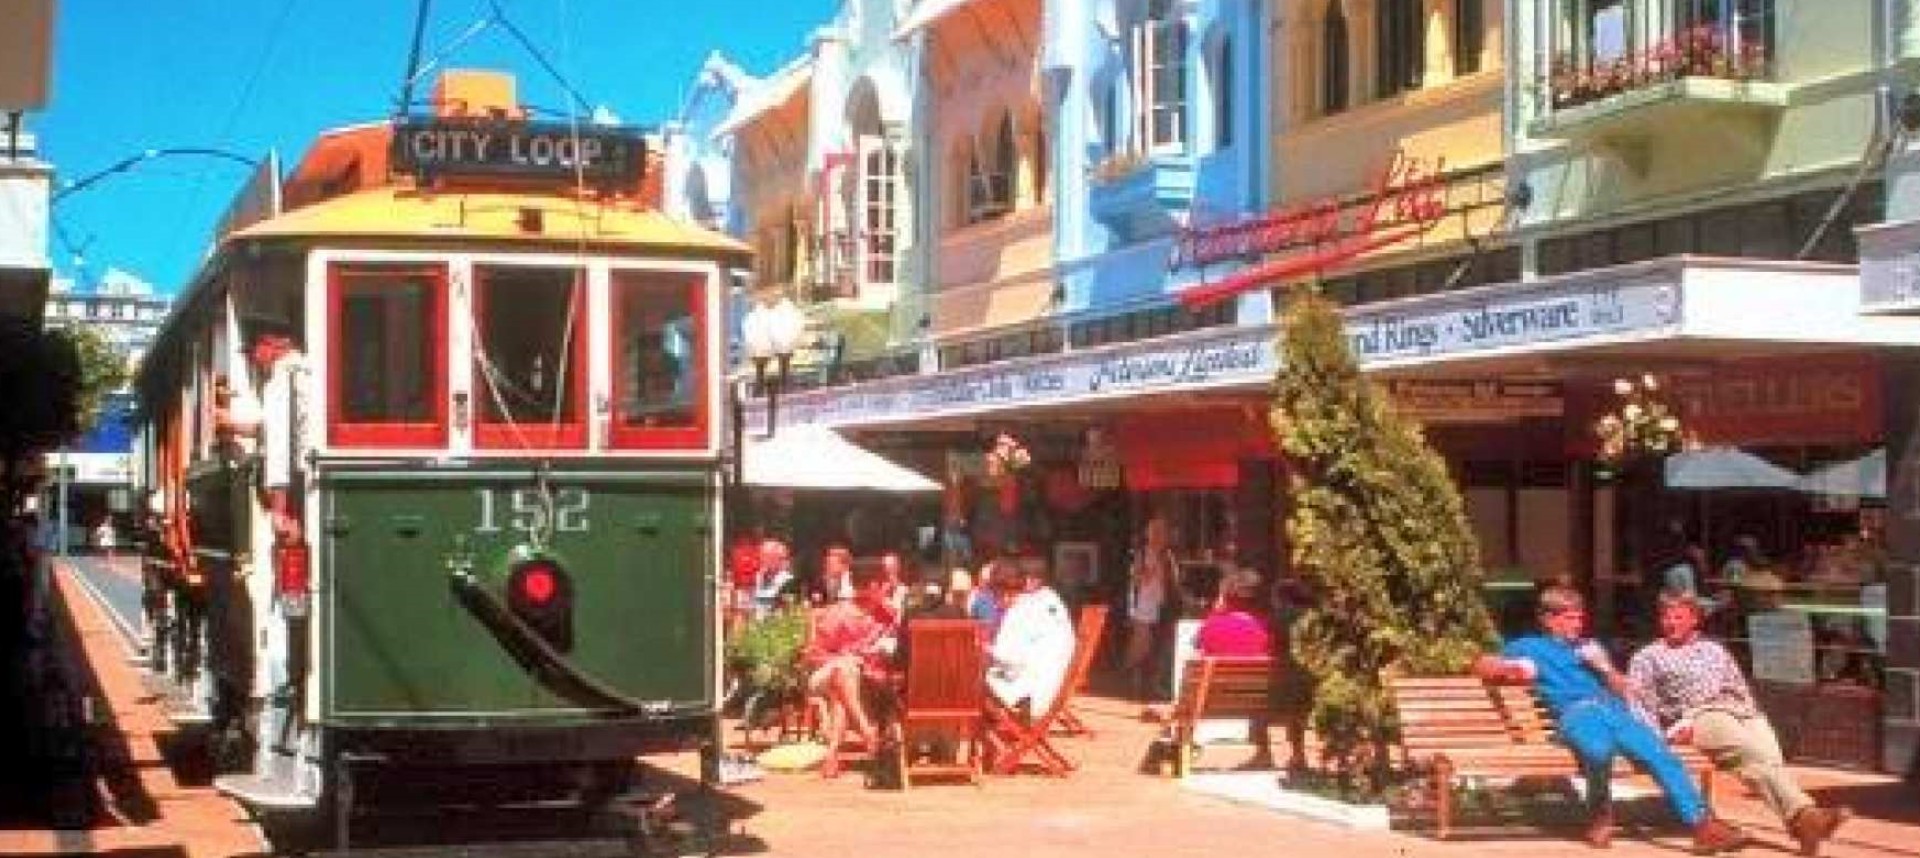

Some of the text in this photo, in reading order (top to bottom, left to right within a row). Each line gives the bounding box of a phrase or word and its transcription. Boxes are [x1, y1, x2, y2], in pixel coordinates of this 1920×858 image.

[414, 129, 601, 168] CITY LOOP
[474, 488, 590, 532] 152
